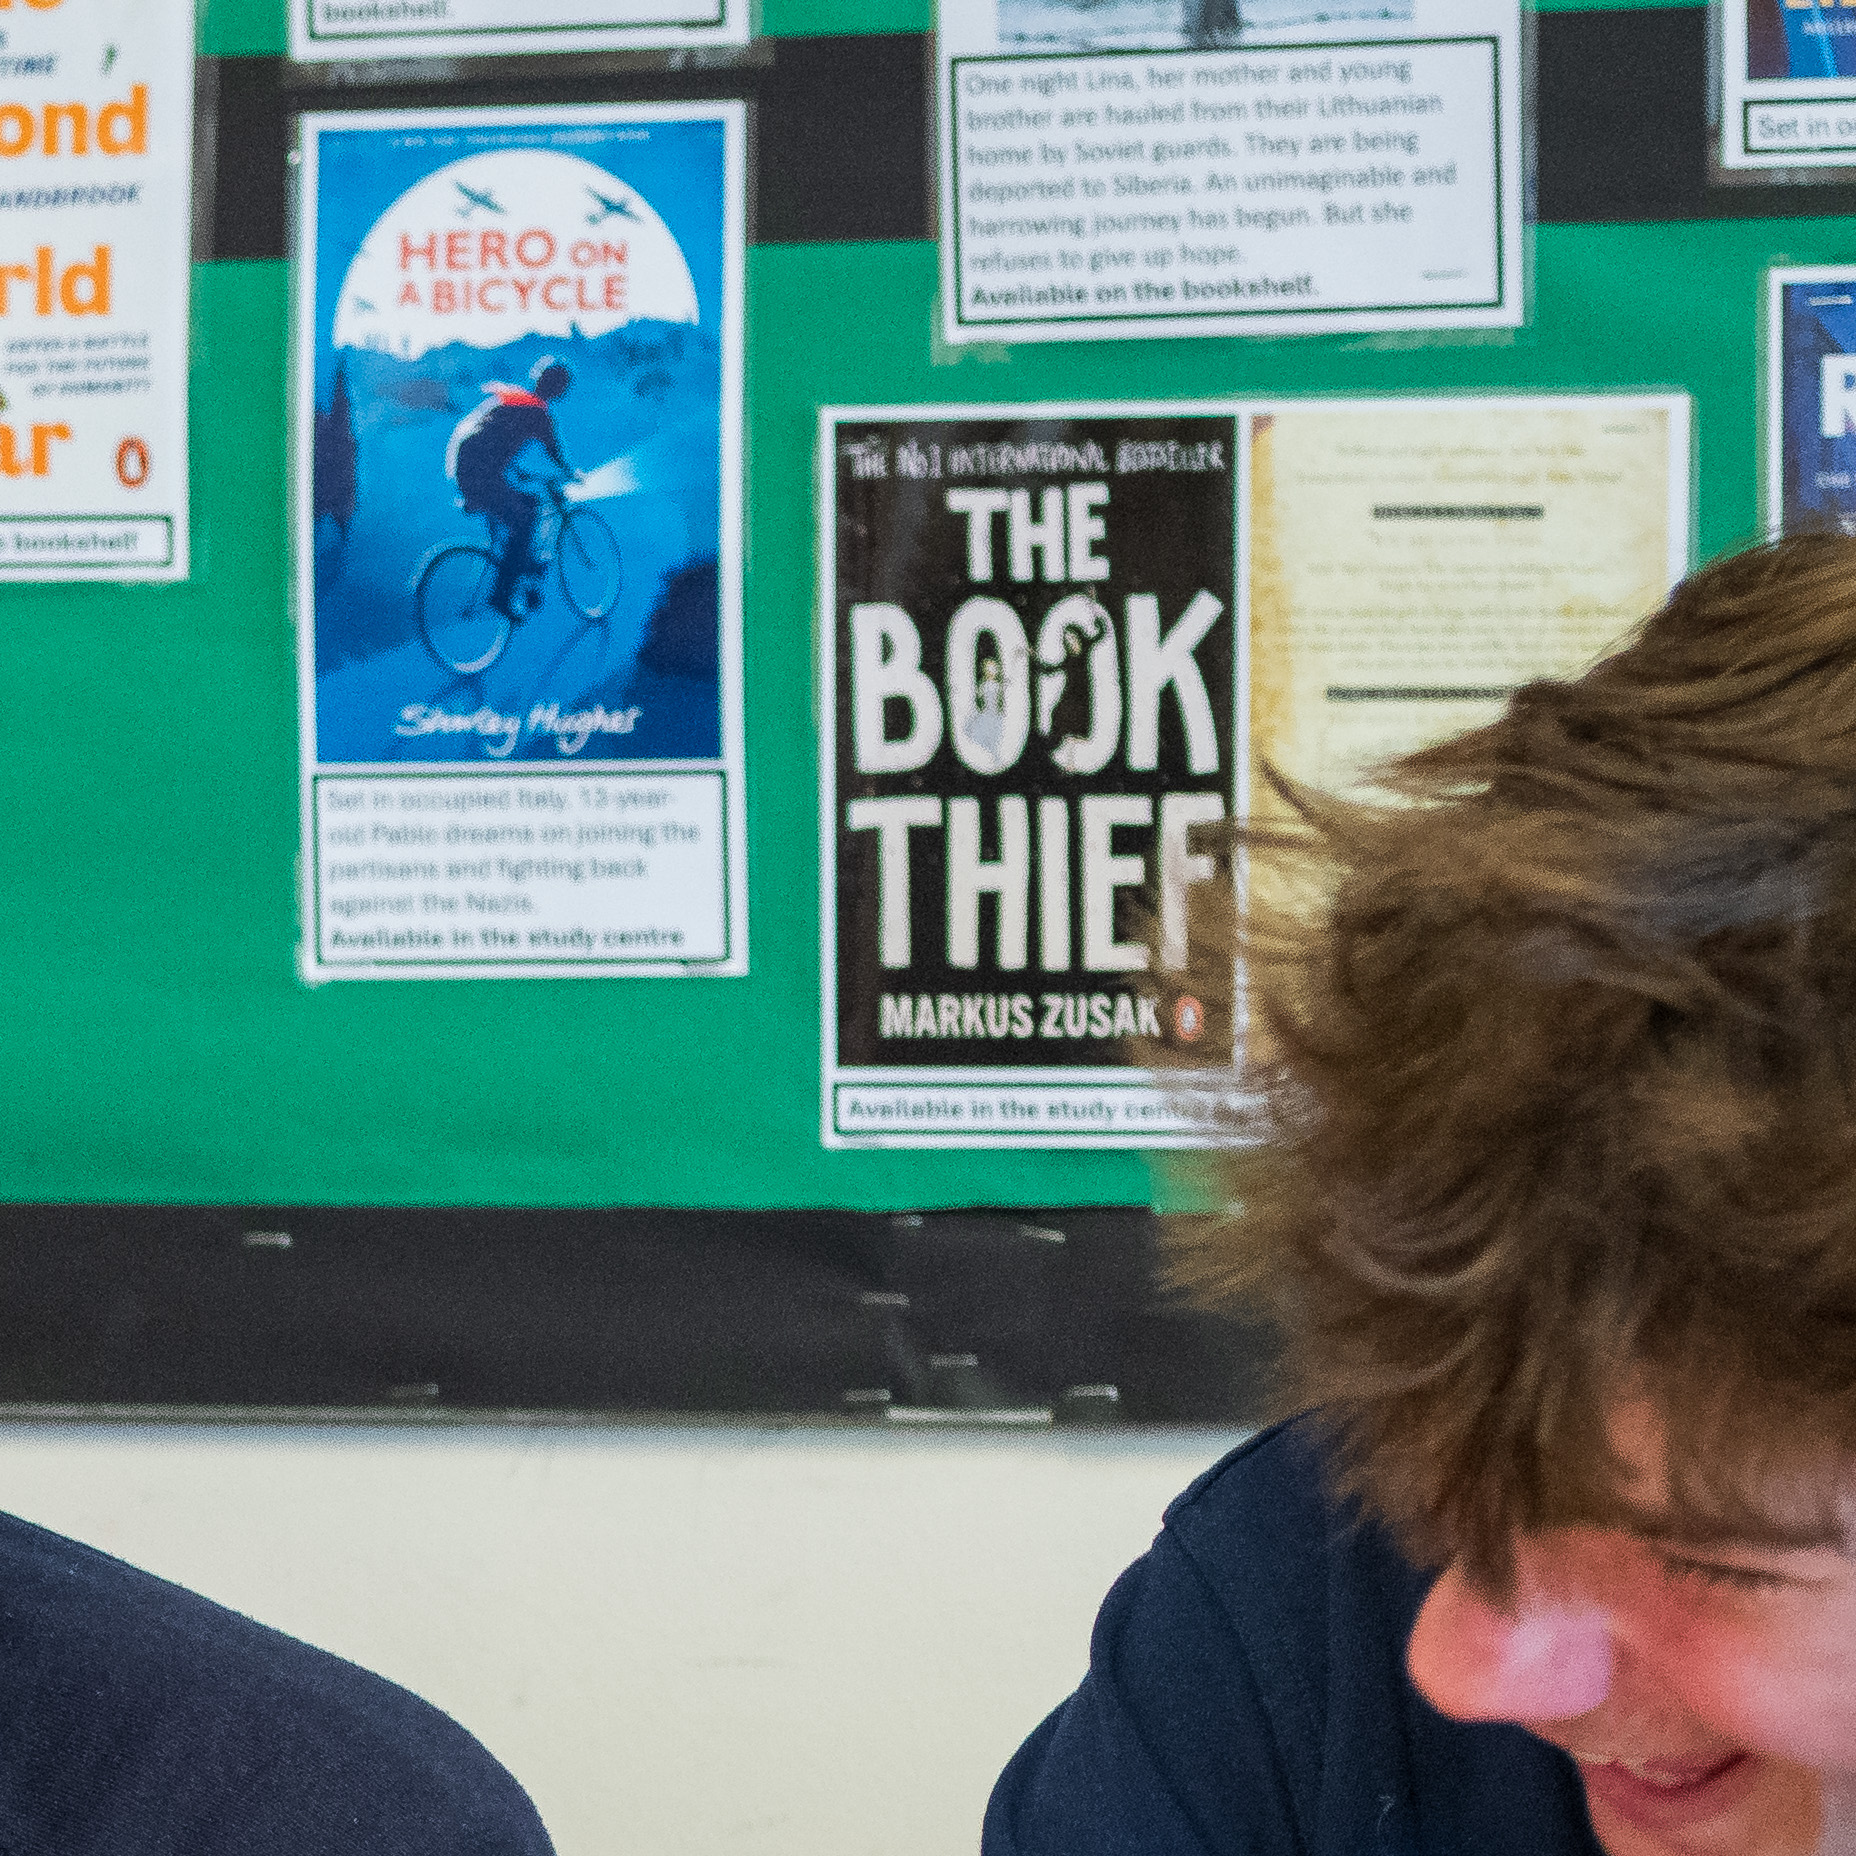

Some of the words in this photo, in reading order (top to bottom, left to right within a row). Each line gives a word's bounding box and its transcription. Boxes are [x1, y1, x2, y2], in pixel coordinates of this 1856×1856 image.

[966, 72, 1011, 98] One
[1021, 70, 1079, 99] night
[1146, 66, 1187, 90] her
[1193, 63, 1280, 88] mother
[1288, 60, 1331, 85] and
[1340, 58, 1413, 88] young
[966, 107, 1052, 133] brother
[1061, 108, 1098, 128] are
[1105, 101, 1184, 127] hauled
[1191, 98, 1248, 123] from
[1255, 96, 1309, 120] their
[1317, 91, 1443, 117] Lithuanian
[1759, 116, 1799, 140] Set
[1808, 114, 1832, 138] in
[966, 144, 1033, 168] home
[1040, 142, 1068, 169] by
[1075, 139, 1145, 163] Soviet
[1246, 133, 1302, 160] They
[1309, 133, 1346, 154] are
[1353, 129, 1418, 157] being
[970, 177, 1075, 206] deported
[1081, 177, 1107, 198] to
[1206, 171, 1238, 193] An
[1244, 164, 1406, 195] unimaginable
[1412, 162, 1456, 187] and
[970, 212, 1085, 239] harrowing
[1089, 210, 1181, 238] journey
[1188, 206, 1228, 229] has
[1323, 201, 1364, 225] But
[1371, 199, 1412, 223] she
[399, 229, 556, 271] HERO
[570, 240, 629, 268] ON
[970, 247, 1052, 272] refuses
[1059, 247, 1083, 269] to
[1090, 246, 1137, 273] give
[1143, 246, 1174, 269] up
[398, 281, 422, 307] A
[432, 275, 628, 316] BICYCLE
[972, 283, 1088, 308] Available
[1095, 284, 1127, 304] on
[1133, 278, 1175, 301] the
[945, 481, 1111, 584] THE
[849, 588, 1226, 776] BOOK
[527, 703, 643, 756] Hughes
[328, 789, 365, 810] Set
[371, 788, 394, 809] in
[400, 788, 509, 817] occupied
[327, 824, 365, 846] old
[372, 823, 437, 845] Pablo
[445, 822, 536, 844] dreams
[543, 827, 568, 844] on
[572, 821, 656, 850] joining
[663, 819, 699, 842] the
[327, 858, 438, 885] partisans
[446, 857, 491, 879] and
[497, 855, 584, 885] fighting
[591, 855, 647, 878] back
[846, 791, 1226, 973] THIEF
[328, 893, 415, 919] against
[421, 893, 460, 914] the
[329, 926, 444, 949] Available
[452, 926, 476, 947] in
[481, 926, 521, 948] the
[527, 925, 597, 953] study
[603, 927, 685, 949] centre
[880, 993, 1033, 1040] MARKUS
[1039, 993, 1160, 1039] ZUSAK
[848, 1096, 965, 1121] Available
[971, 1097, 994, 1120] in
[999, 1097, 1044, 1120] the
[1047, 1096, 1118, 1125] study
